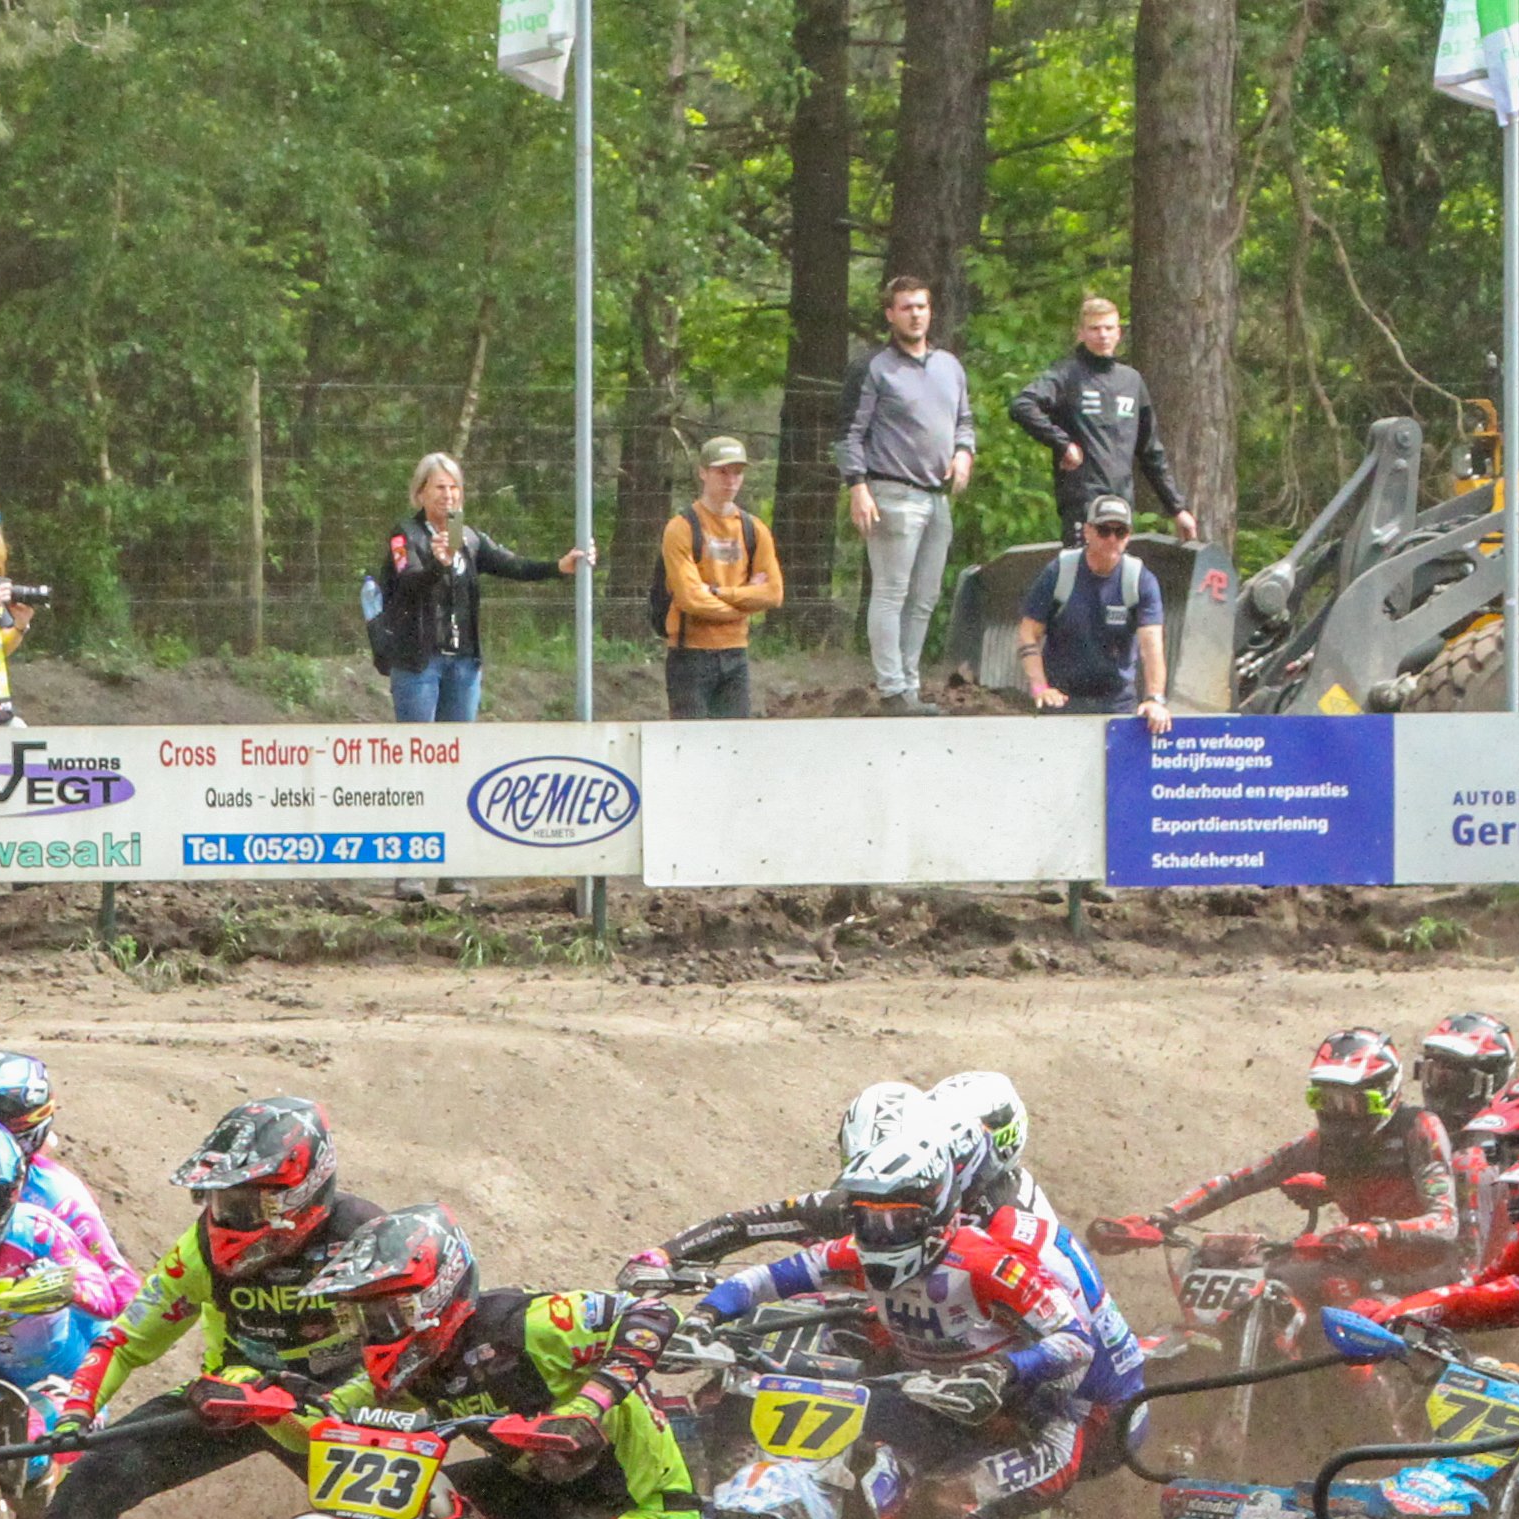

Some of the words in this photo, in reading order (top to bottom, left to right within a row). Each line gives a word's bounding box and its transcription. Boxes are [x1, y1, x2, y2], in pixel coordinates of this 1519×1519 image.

[158, 739, 217, 767] Cross
[241, 738, 311, 767] Enduro
[332, 738, 362, 767] Off
[366, 738, 404, 766] The
[409, 736, 460, 766] Road
[1176, 738, 1197, 750] en
[1199, 734, 1266, 755] verkoop
[47, 757, 121, 772] MOTORS
[1151, 752, 1273, 772] bedrijfswagens
[205, 787, 252, 809] Quads
[270, 786, 315, 808] Jetski
[332, 786, 424, 808] Generatoren
[485, 769, 624, 828] PREMIER
[1151, 783, 1243, 799] Onderhoud
[1245, 787, 1265, 799] en
[1267, 782, 1349, 803] reparaties
[187, 836, 234, 862] Tel.
[242, 835, 325, 864] (0529)
[331, 835, 363, 861] 47
[372, 835, 402, 860] 13
[407, 835, 441, 860] 86
[1151, 852, 1265, 869] Schadeherstel
[768, 1399, 857, 1451] 17
[315, 1448, 422, 1511] 723
